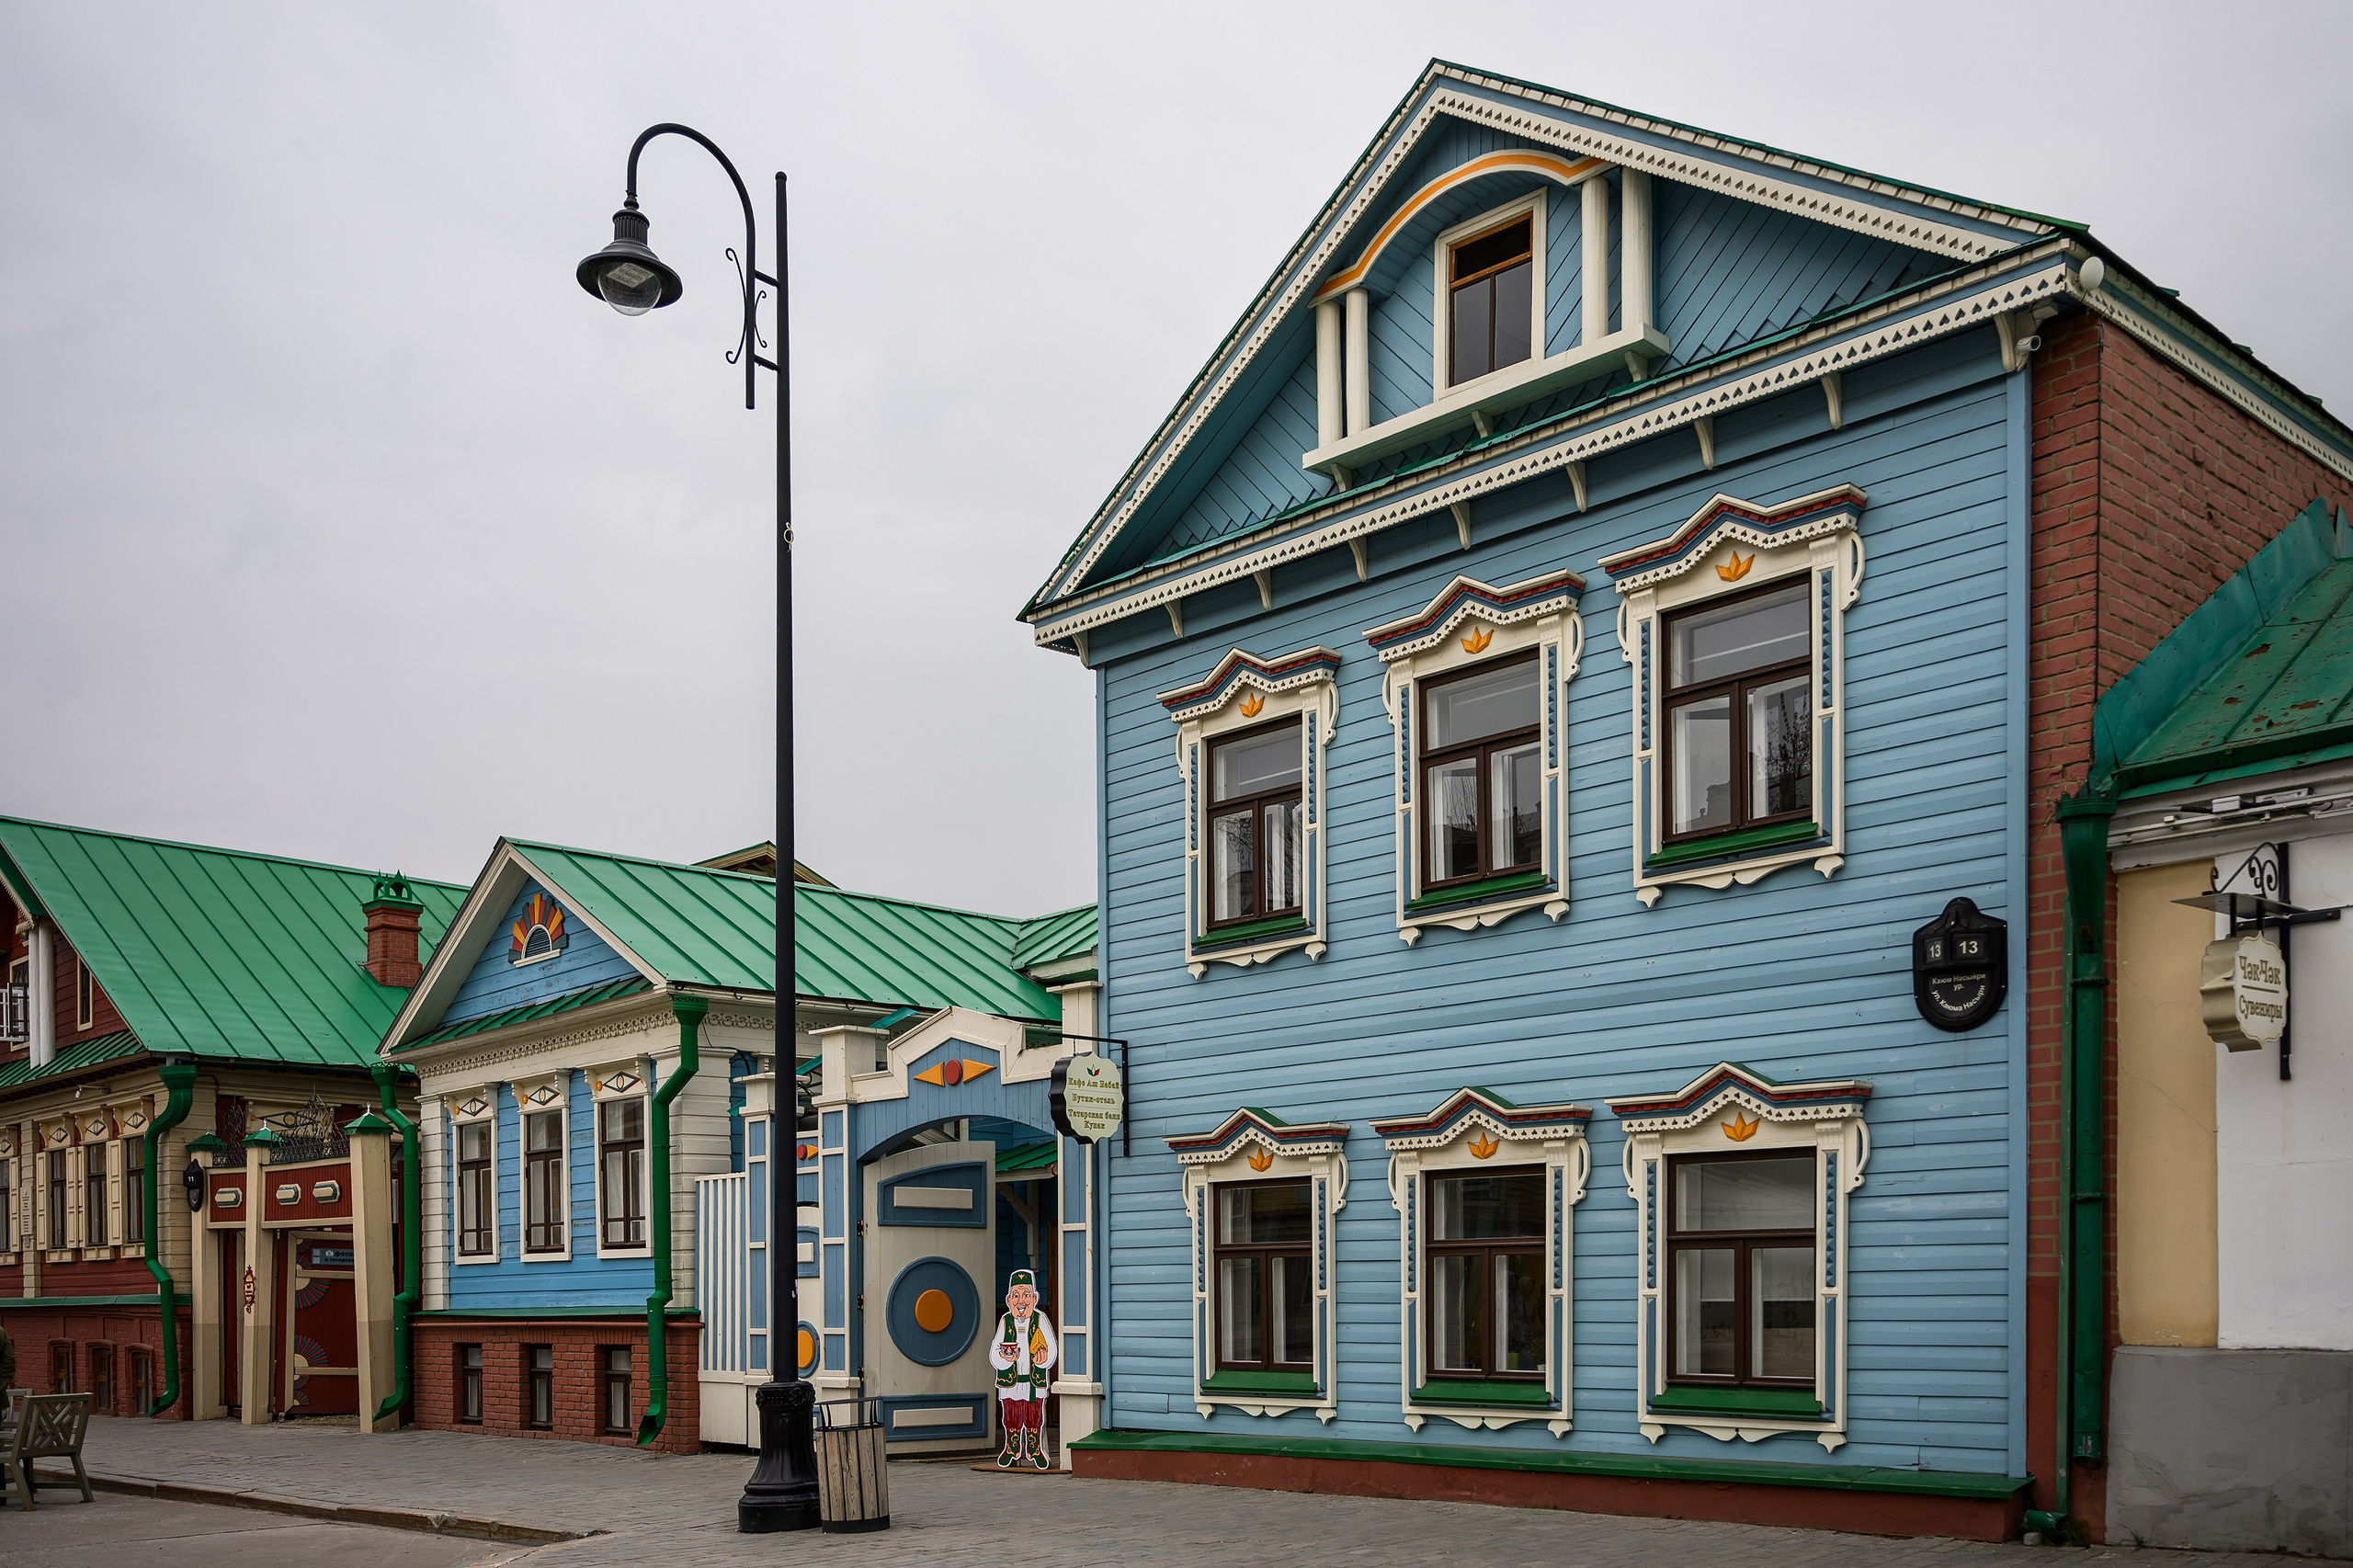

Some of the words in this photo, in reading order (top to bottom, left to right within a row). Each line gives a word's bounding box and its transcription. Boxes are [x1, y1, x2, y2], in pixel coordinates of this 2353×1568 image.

[1930, 944, 1941, 958] 13
[1960, 940, 1978, 954] 13
[1953, 983, 1965, 992] ур.
[1931, 990, 1939, 1001] ул.
[1939, 999, 1962, 1011] Каюма
[1963, 984, 1985, 1009] Насыри
[2239, 994, 2283, 1023] Сувениры
[1068, 1077, 1085, 1087] Кафе
[1072, 1094, 1115, 1104] Бутик-отель
[1068, 1108, 1104, 1119] Татарская
[1104, 1111, 1120, 1119] баня
